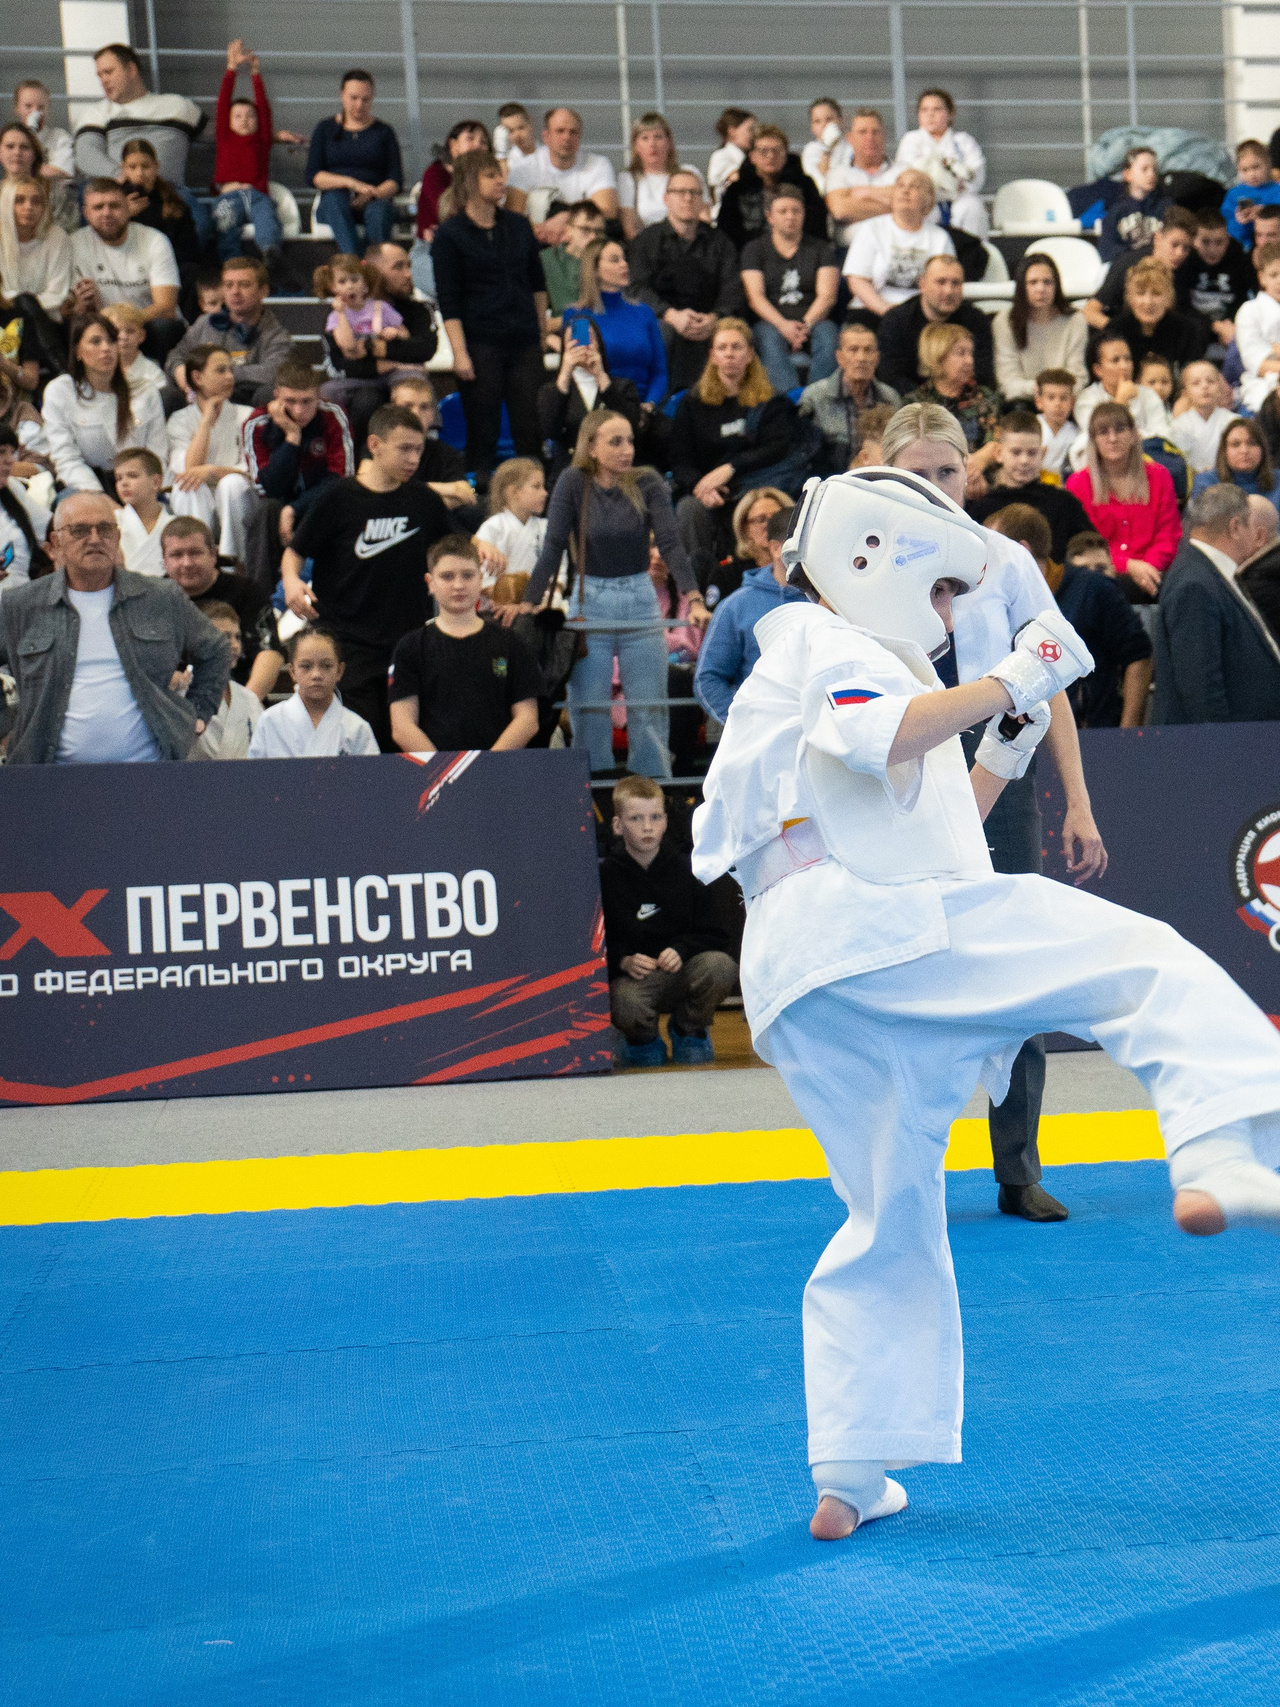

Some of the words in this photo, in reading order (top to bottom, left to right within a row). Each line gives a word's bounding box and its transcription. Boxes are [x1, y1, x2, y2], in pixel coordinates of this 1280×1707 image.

[364, 516, 409, 540] NIKE
[1236, 829, 1257, 898] ФЕДЕРАЦИЯ
[126, 869, 499, 955] ПЕРВЕНСТВО
[33, 958, 324, 996] ФЕДЕРАЛЬНОГО
[338, 949, 473, 980] ОКРУГА
